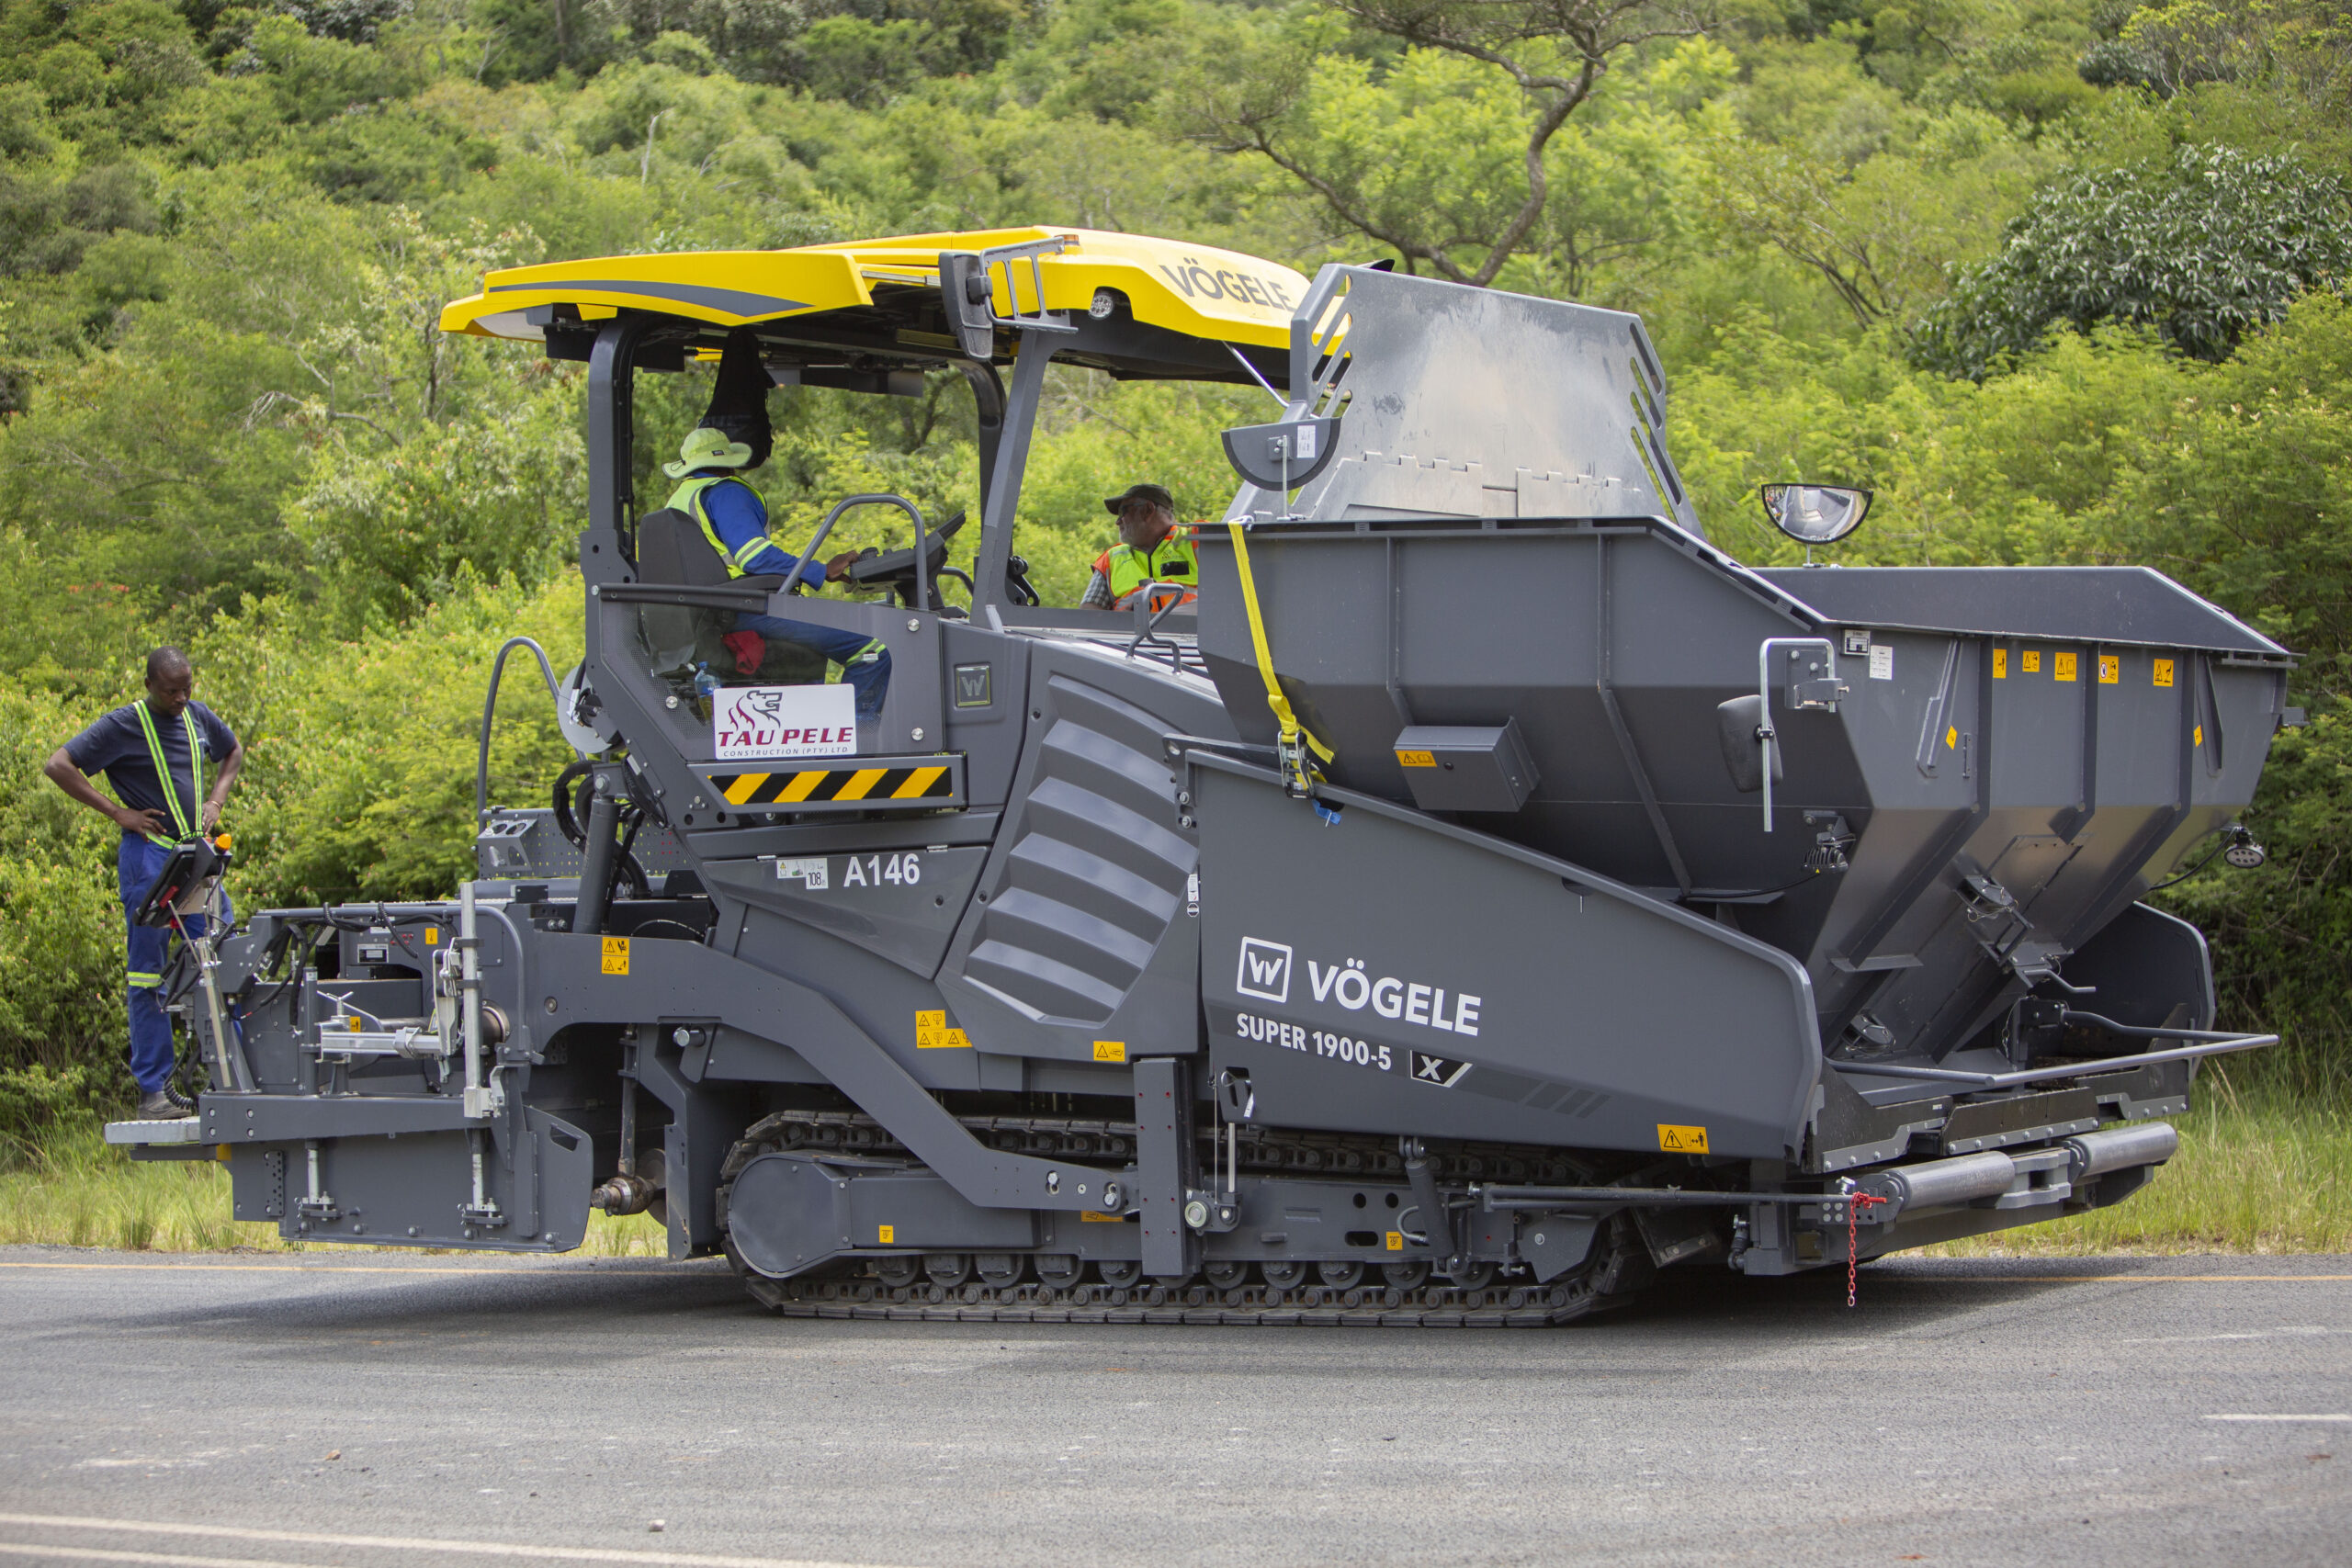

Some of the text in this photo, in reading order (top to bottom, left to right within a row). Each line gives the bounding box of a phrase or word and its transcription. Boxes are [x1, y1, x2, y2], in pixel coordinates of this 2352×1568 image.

[1159, 256, 1297, 312] VÖGELE
[718, 727, 854, 747] TAU PELE
[723, 748, 798, 757] CONSTRUCTION
[802, 747, 828, 755] (PTY)
[808, 872, 821, 886] 108
[843, 852, 921, 887] A146
[1248, 951, 1283, 986] W
[1307, 957, 1481, 1036] VÖGELE
[1237, 1012, 1392, 1071] SUPER 1900-5
[1418, 1054, 1444, 1081] X
